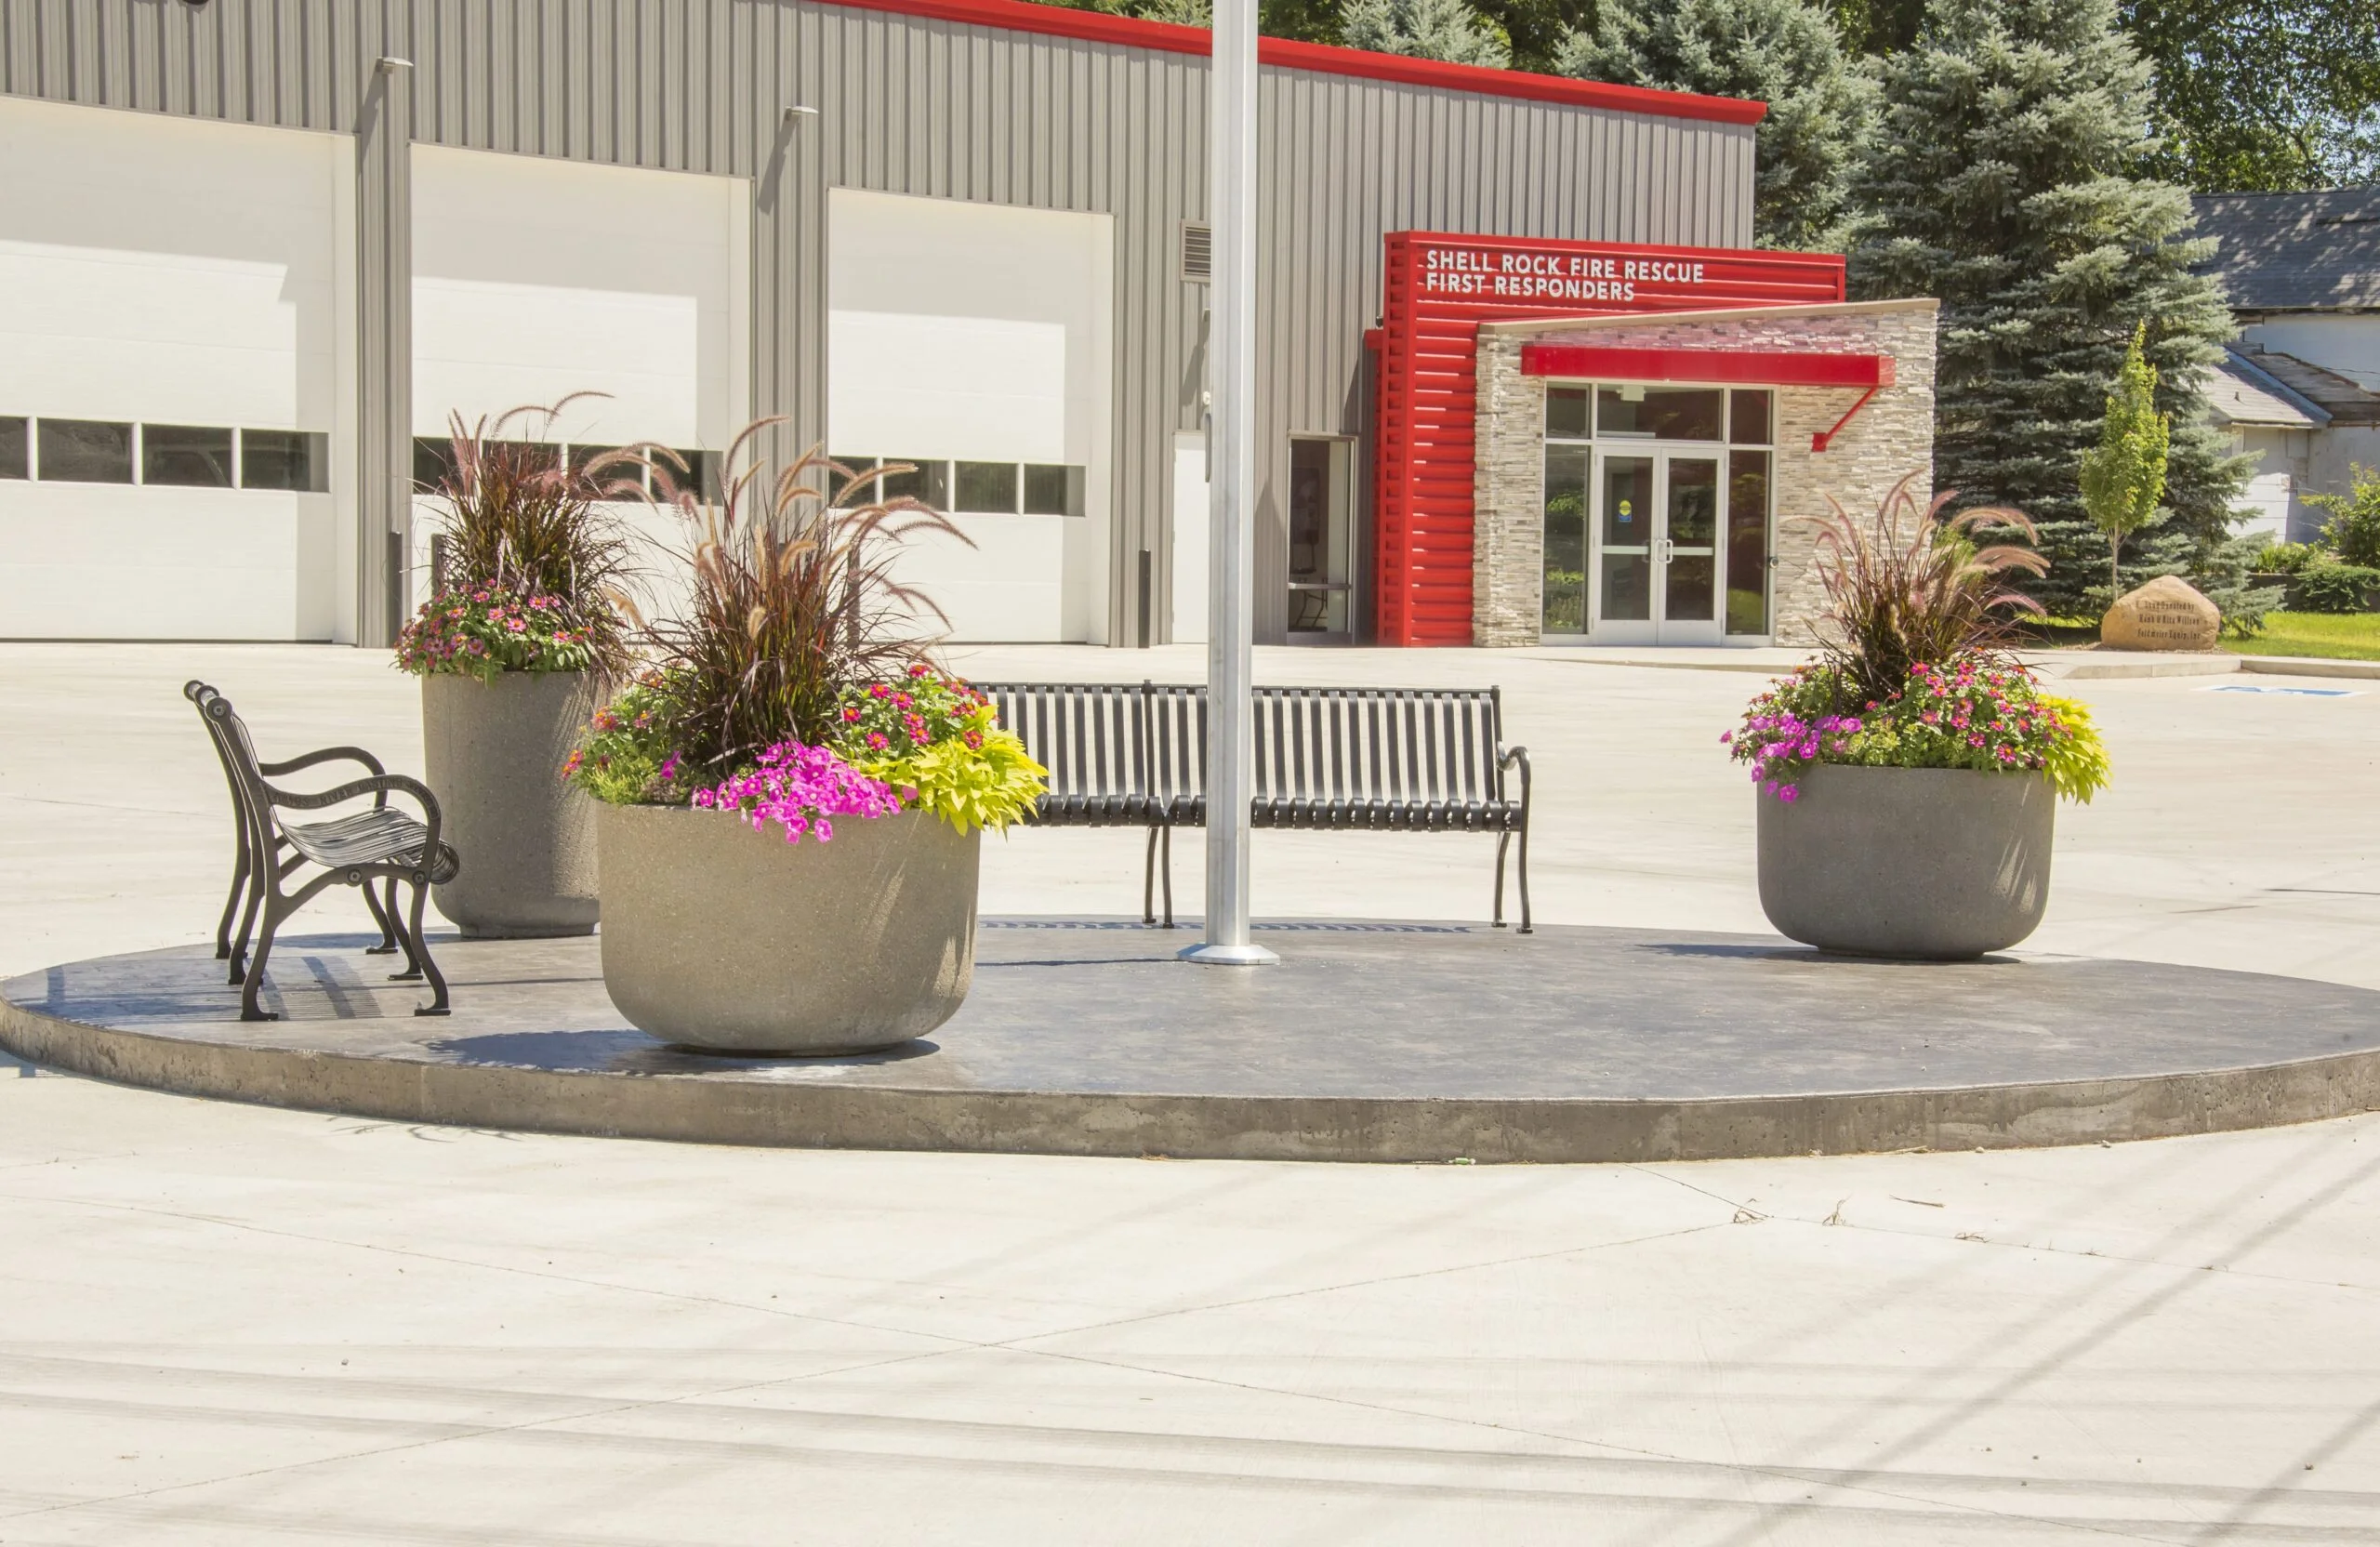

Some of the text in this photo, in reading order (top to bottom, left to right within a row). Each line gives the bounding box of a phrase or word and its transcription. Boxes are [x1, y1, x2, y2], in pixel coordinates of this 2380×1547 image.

[1426, 249, 1704, 284] SHELL ROCK FIRE RESCUE
[1426, 271, 1634, 301] FIRST RESPONDERS
[2161, 601, 2187, 611] Donated
[2188, 602, 2195, 614] by
[2162, 615, 2175, 625] Rita
